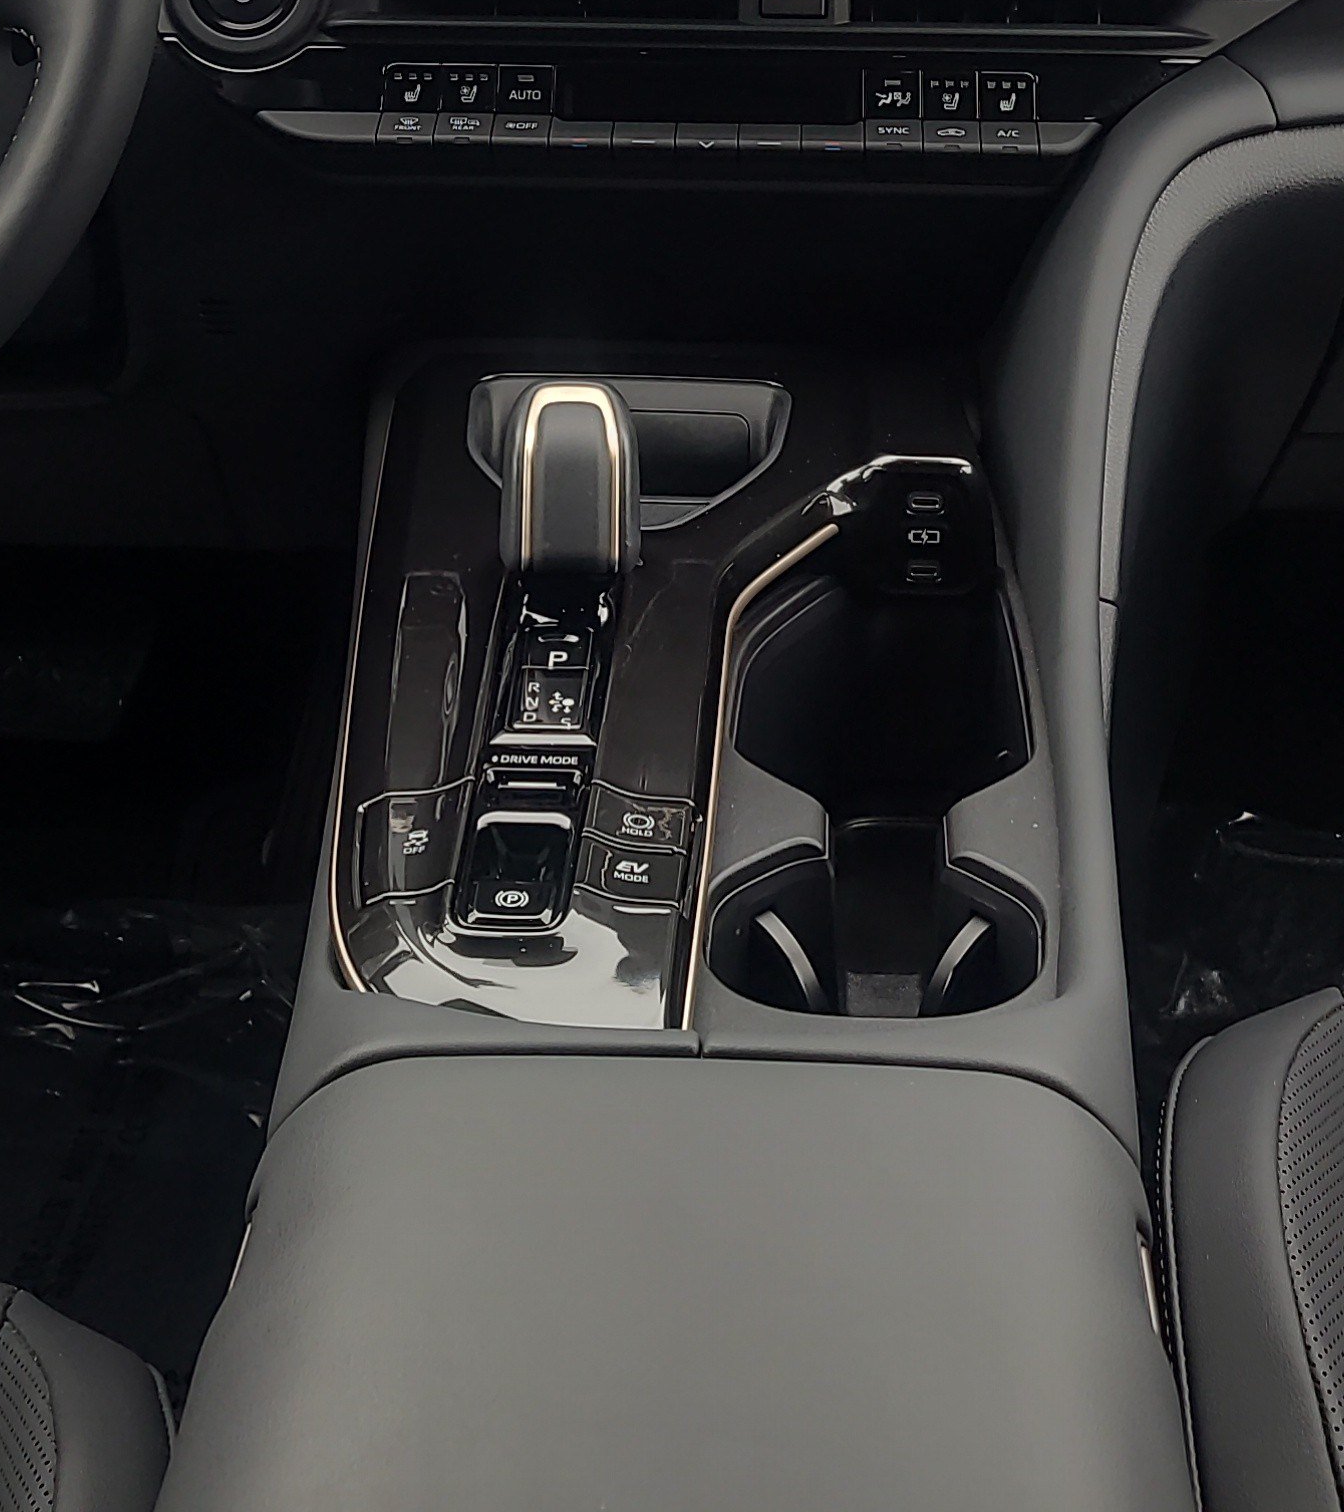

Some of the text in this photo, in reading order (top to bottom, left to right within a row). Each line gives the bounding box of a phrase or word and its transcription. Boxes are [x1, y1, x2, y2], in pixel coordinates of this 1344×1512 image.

[509, 89, 541, 100] AUTO
[515, 122, 538, 130] OFF
[877, 126, 910, 135] SYNC
[997, 128, 1020, 137] A/C
[548, 650, 569, 670] P
[527, 681, 541, 693] R
[525, 696, 539, 709] N
[523, 711, 537, 723] D
[560, 717, 573, 729] S
[500, 754, 579, 765] DRIVE MODE
[621, 826, 654, 837] HOLD
[403, 844, 426, 855] OFF
[617, 861, 649, 874] EV
[613, 870, 649, 883] MODE
